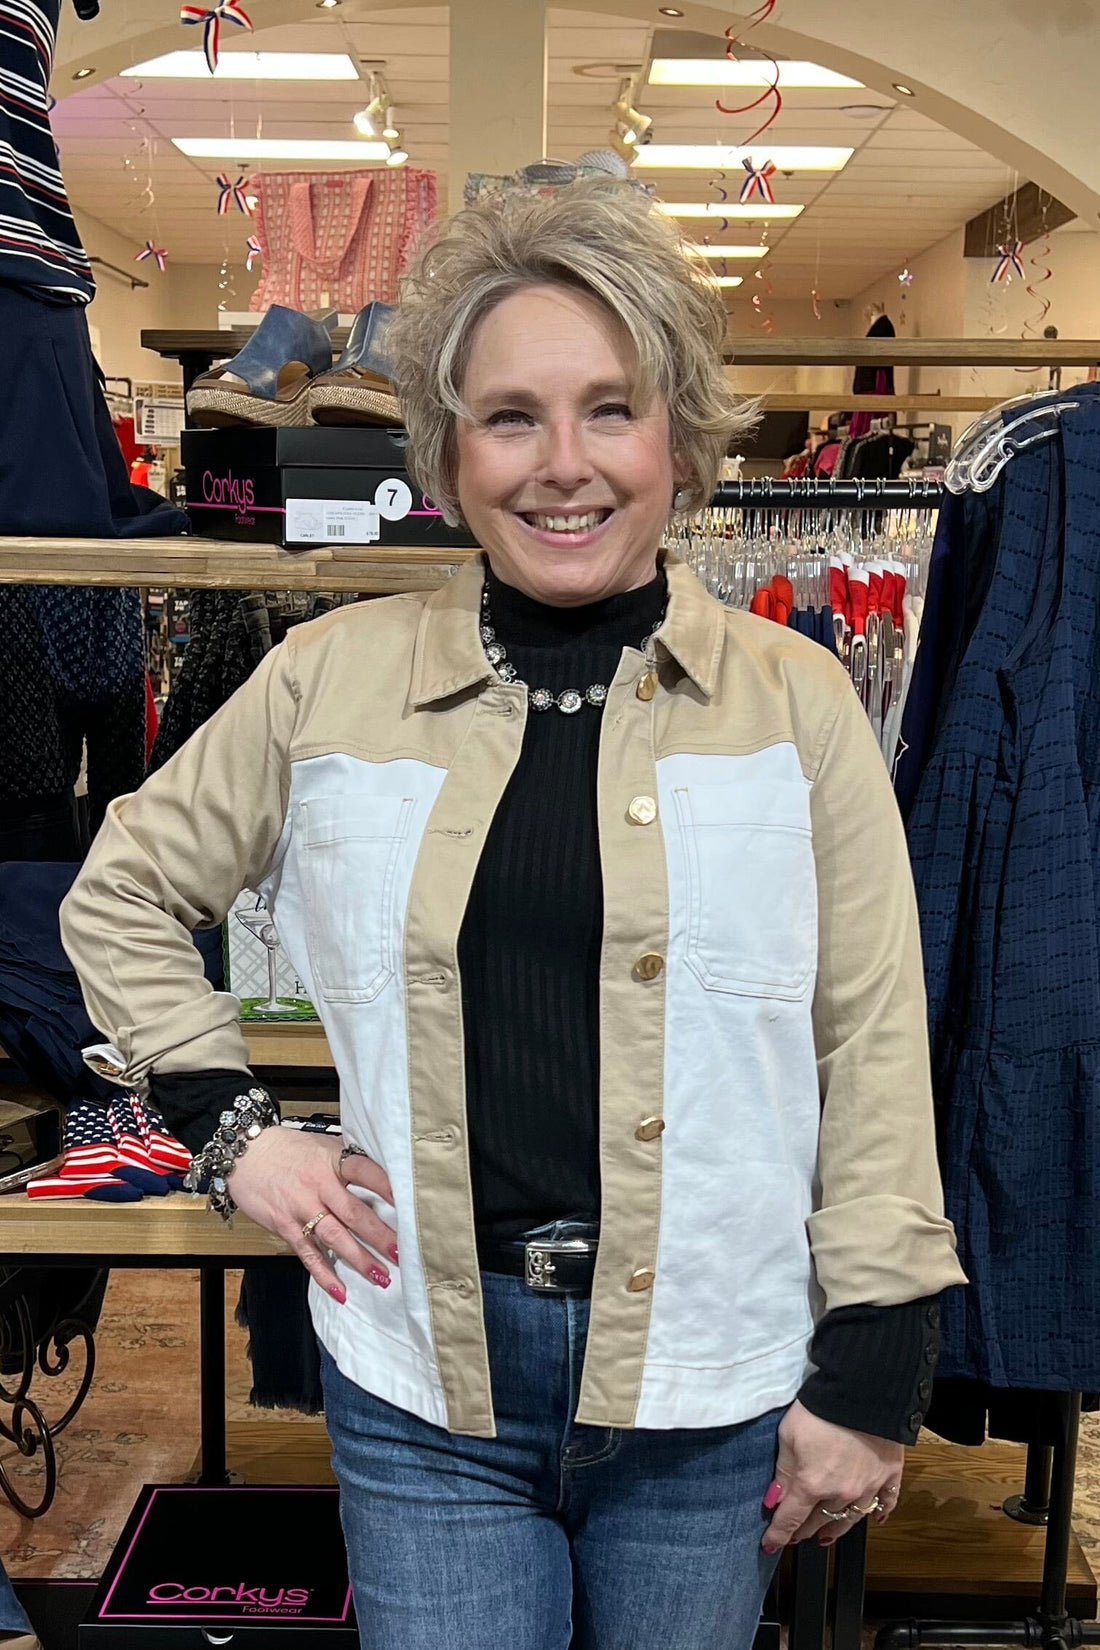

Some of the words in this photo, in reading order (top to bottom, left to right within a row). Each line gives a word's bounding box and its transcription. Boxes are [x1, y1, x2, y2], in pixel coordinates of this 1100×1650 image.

[203, 469, 255, 514] Corkys
[387, 488, 398, 506] 7
[149, 1582, 309, 1607] Corkys
[242, 1605, 303, 1614] Footwear
